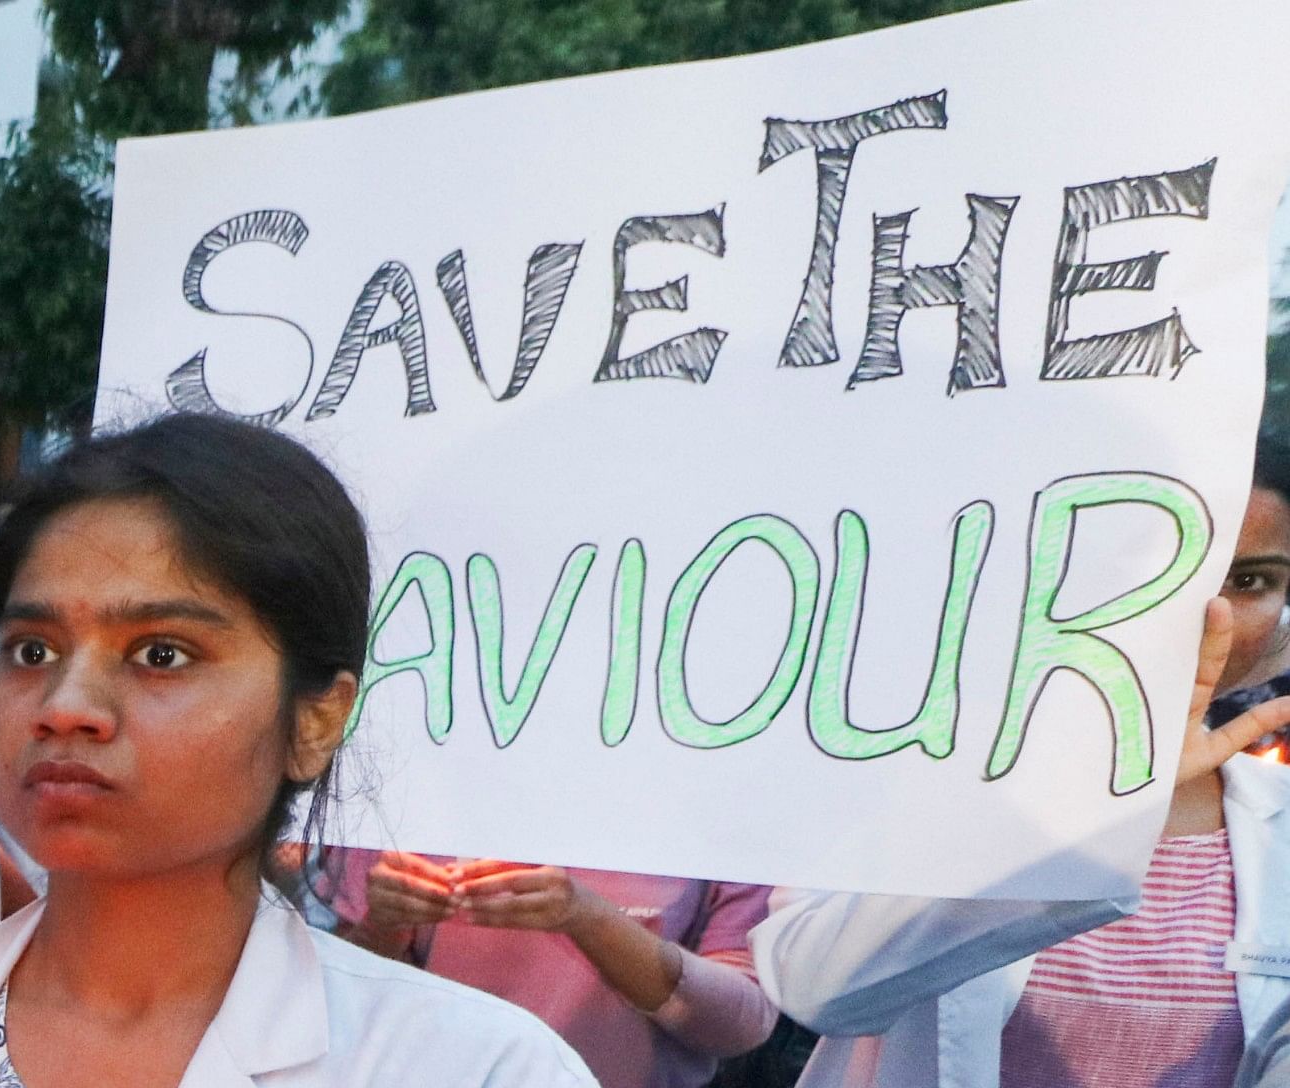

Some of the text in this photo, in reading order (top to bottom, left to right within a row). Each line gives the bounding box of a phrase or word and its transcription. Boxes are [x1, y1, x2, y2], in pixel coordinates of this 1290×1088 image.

[165, 87, 1218, 425] SAVE THE
[343, 472, 1214, 796] AVIOUR
